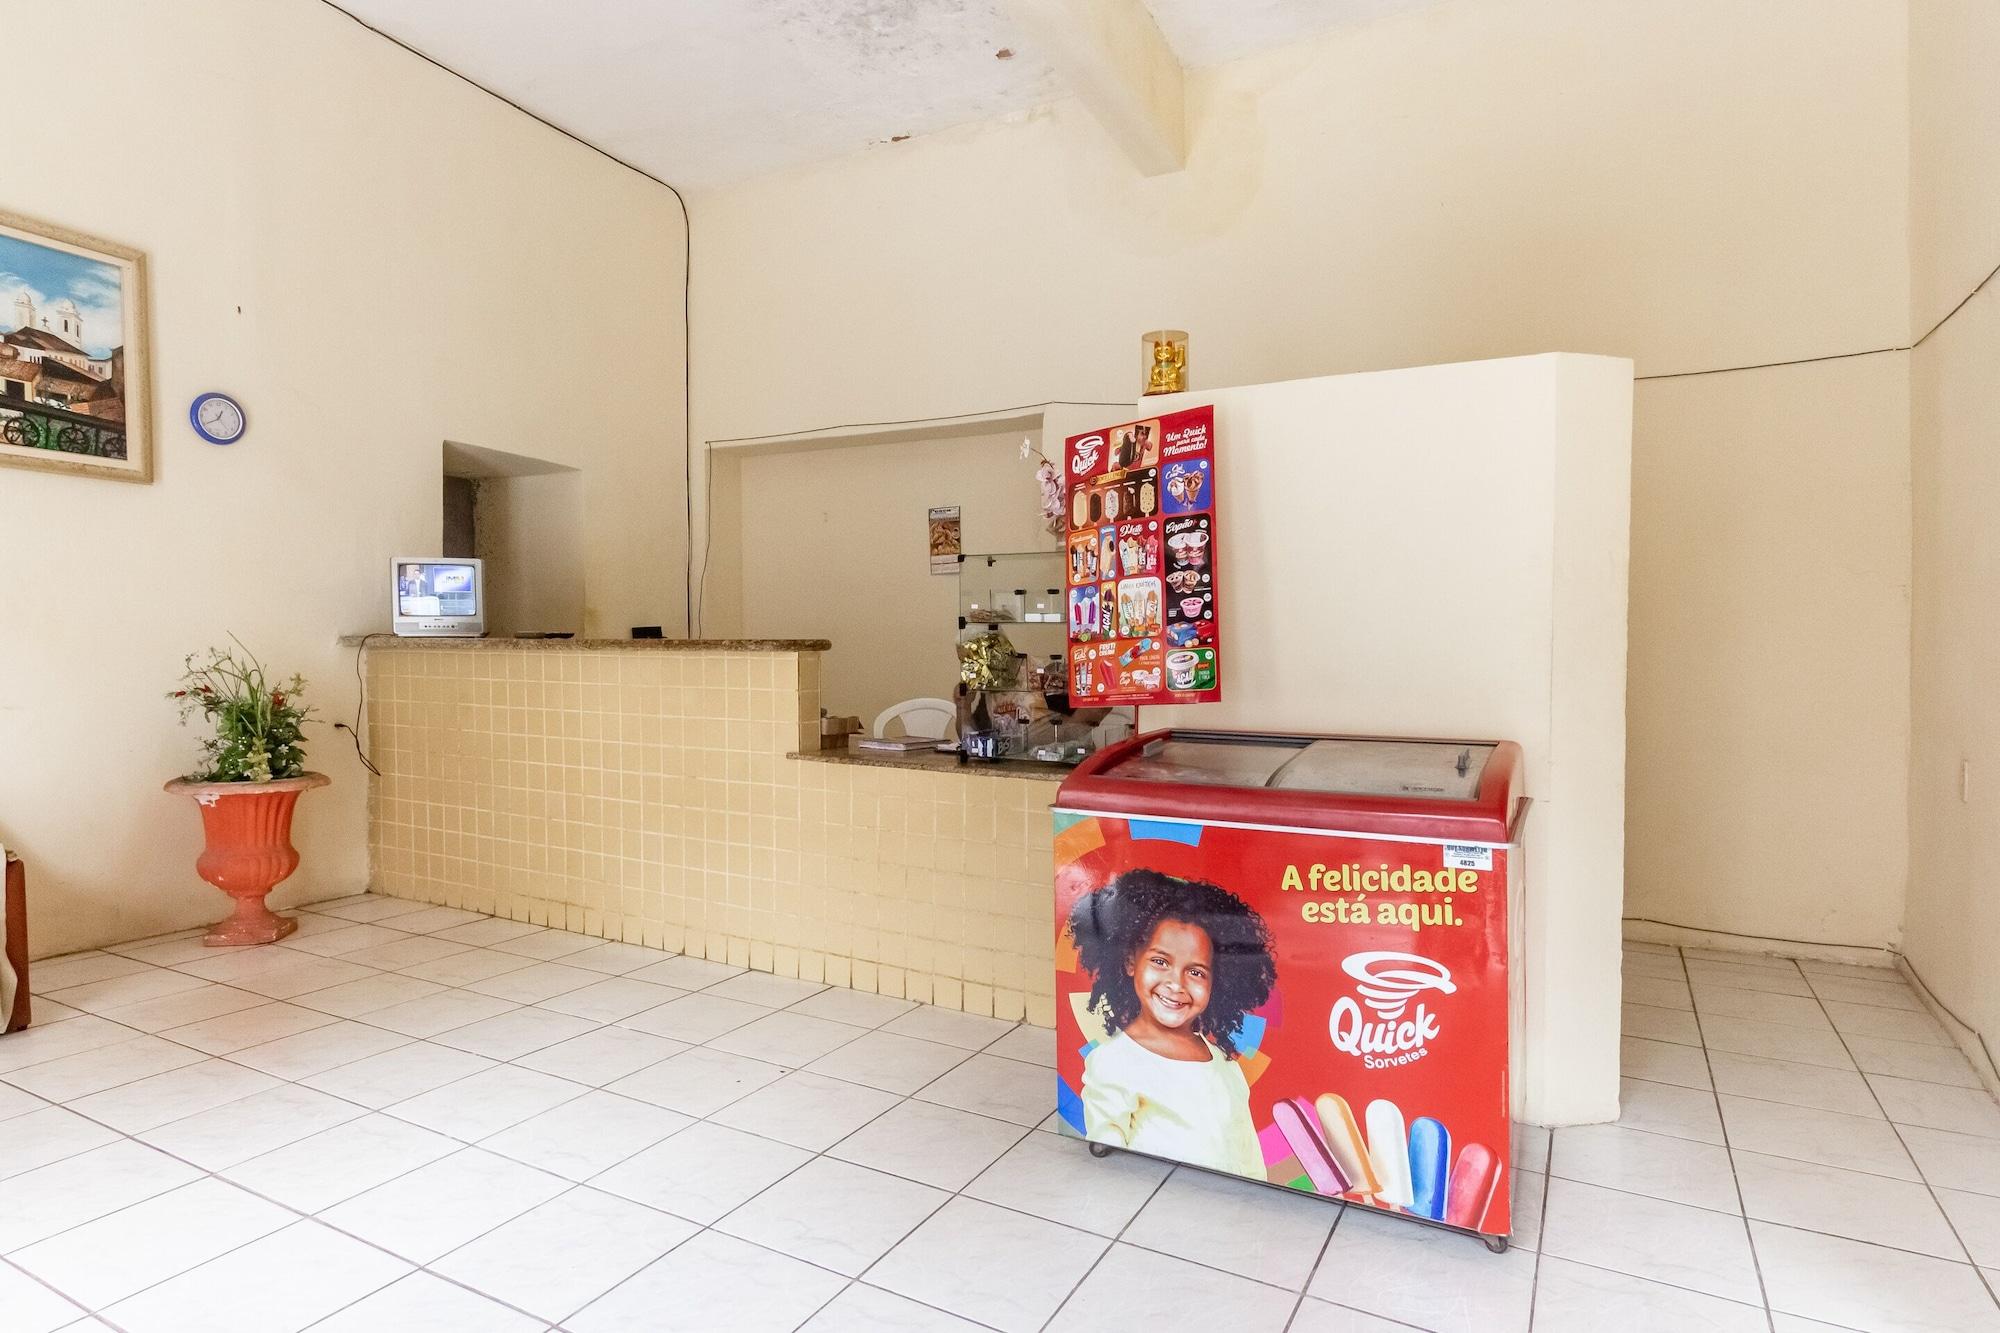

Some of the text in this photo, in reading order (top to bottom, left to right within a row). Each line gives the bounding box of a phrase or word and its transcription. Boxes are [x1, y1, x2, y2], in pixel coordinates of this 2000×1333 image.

[1165, 424, 1206, 442] Um Quick
[1163, 439, 1207, 457] Momento!
[1072, 450, 1099, 474] Quick
[1281, 864, 1478, 893] A felicidade
[1301, 893, 1463, 932] está aqui.
[1329, 996, 1440, 1056] Quick
[1364, 1047, 1428, 1069] Sorvetes
